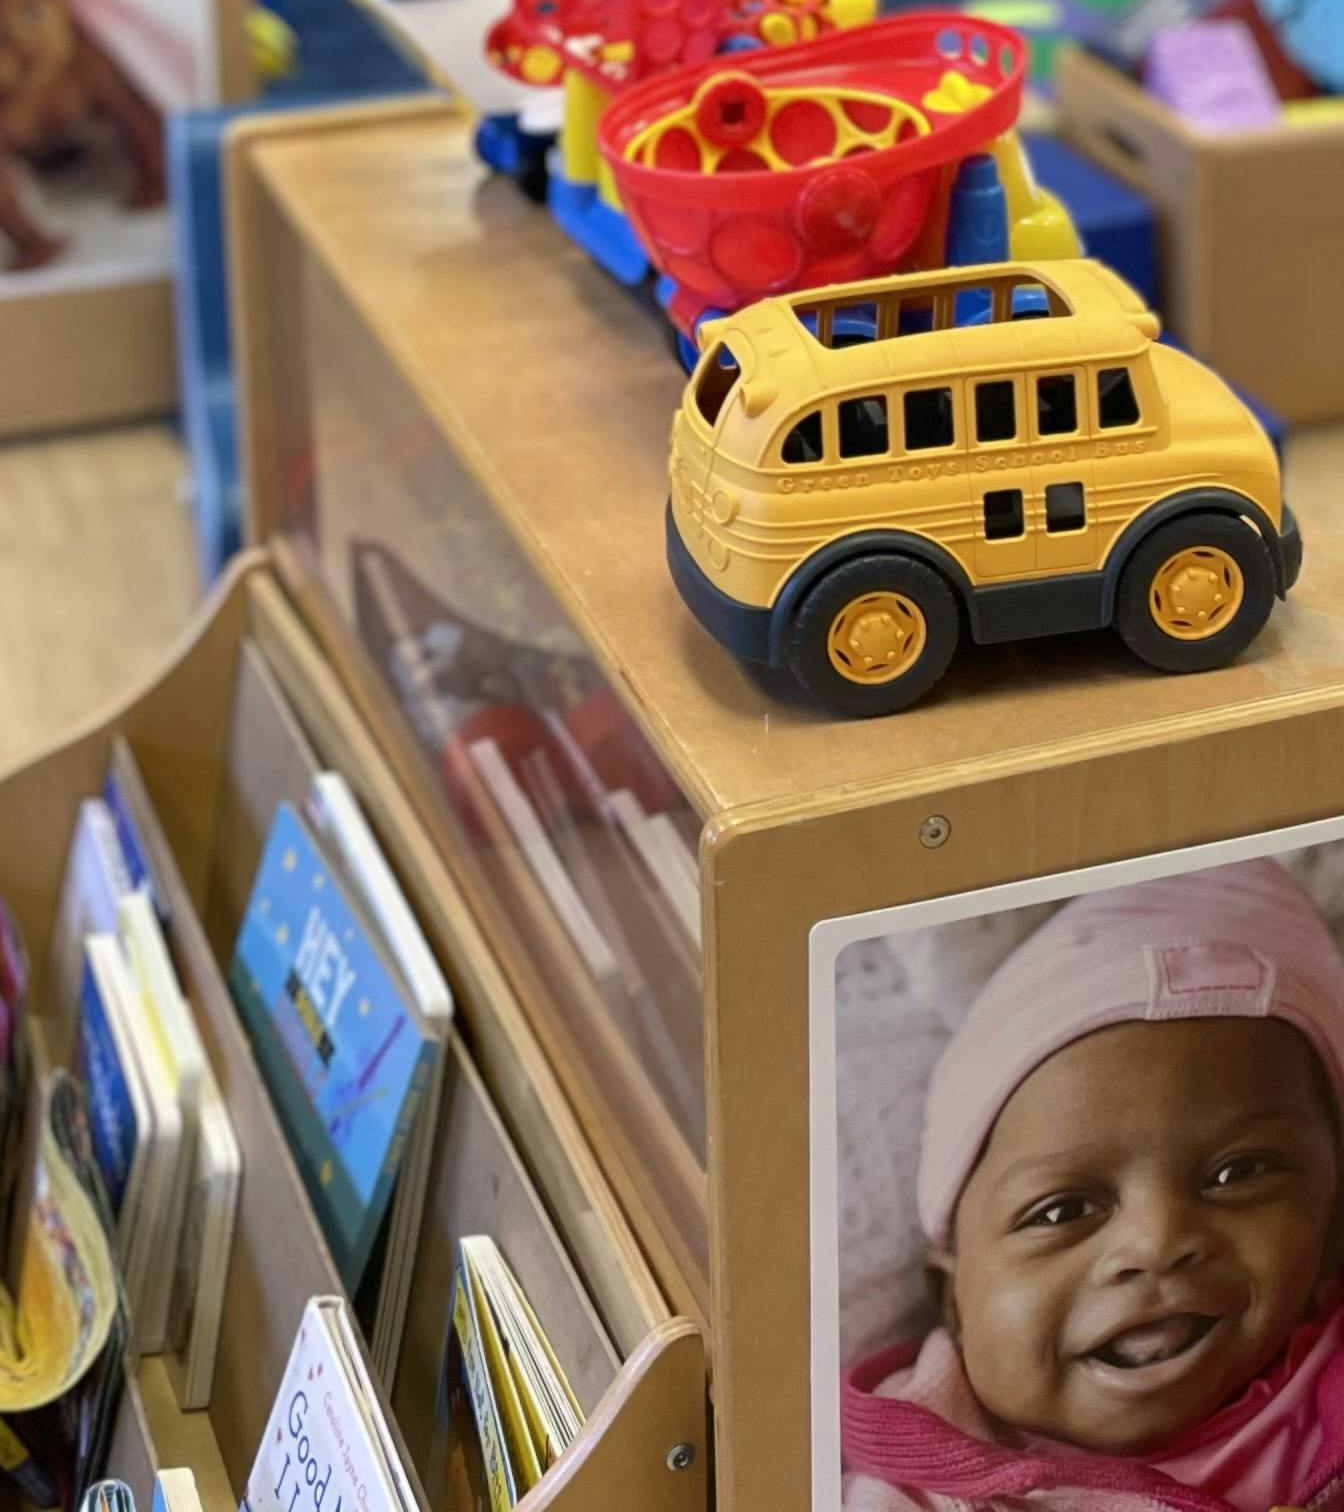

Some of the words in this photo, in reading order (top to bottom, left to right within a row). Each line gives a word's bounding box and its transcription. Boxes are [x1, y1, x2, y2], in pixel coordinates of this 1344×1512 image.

[776, 474, 870, 494] Green
[887, 462, 958, 482] Toys
[974, 444, 1077, 473] School
[1096, 438, 1147, 458] Bus
[293, 904, 357, 1030] HEY
[288, 1390, 332, 1512] Good
